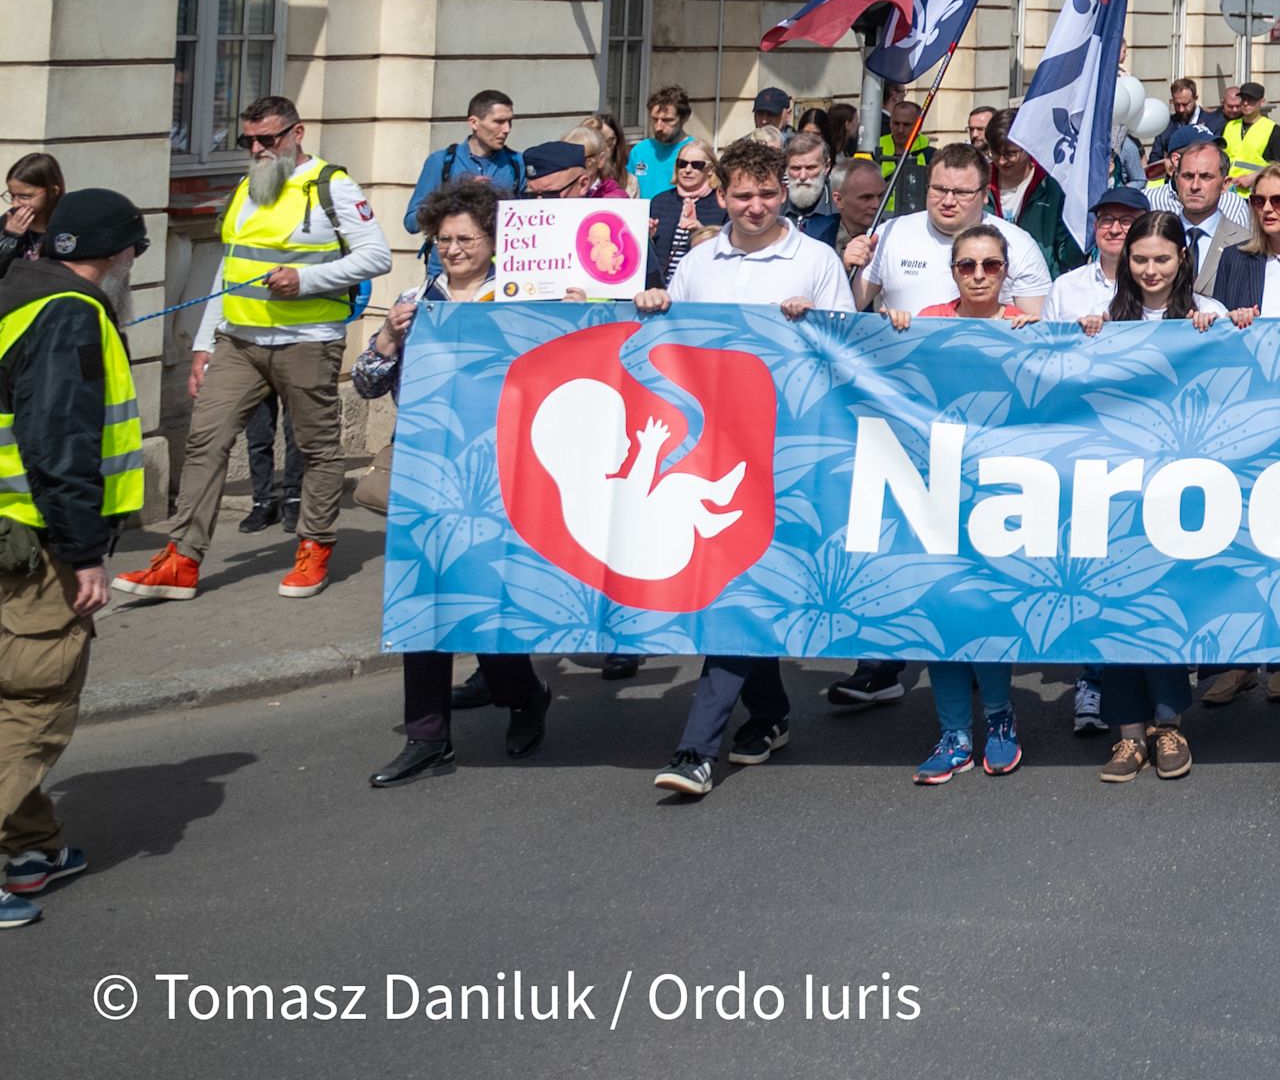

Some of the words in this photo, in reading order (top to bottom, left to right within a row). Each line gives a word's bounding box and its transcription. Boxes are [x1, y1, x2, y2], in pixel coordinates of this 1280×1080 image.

[505, 207, 556, 230] Życie
[503, 233, 538, 253] jest
[502, 253, 572, 272] darem!
